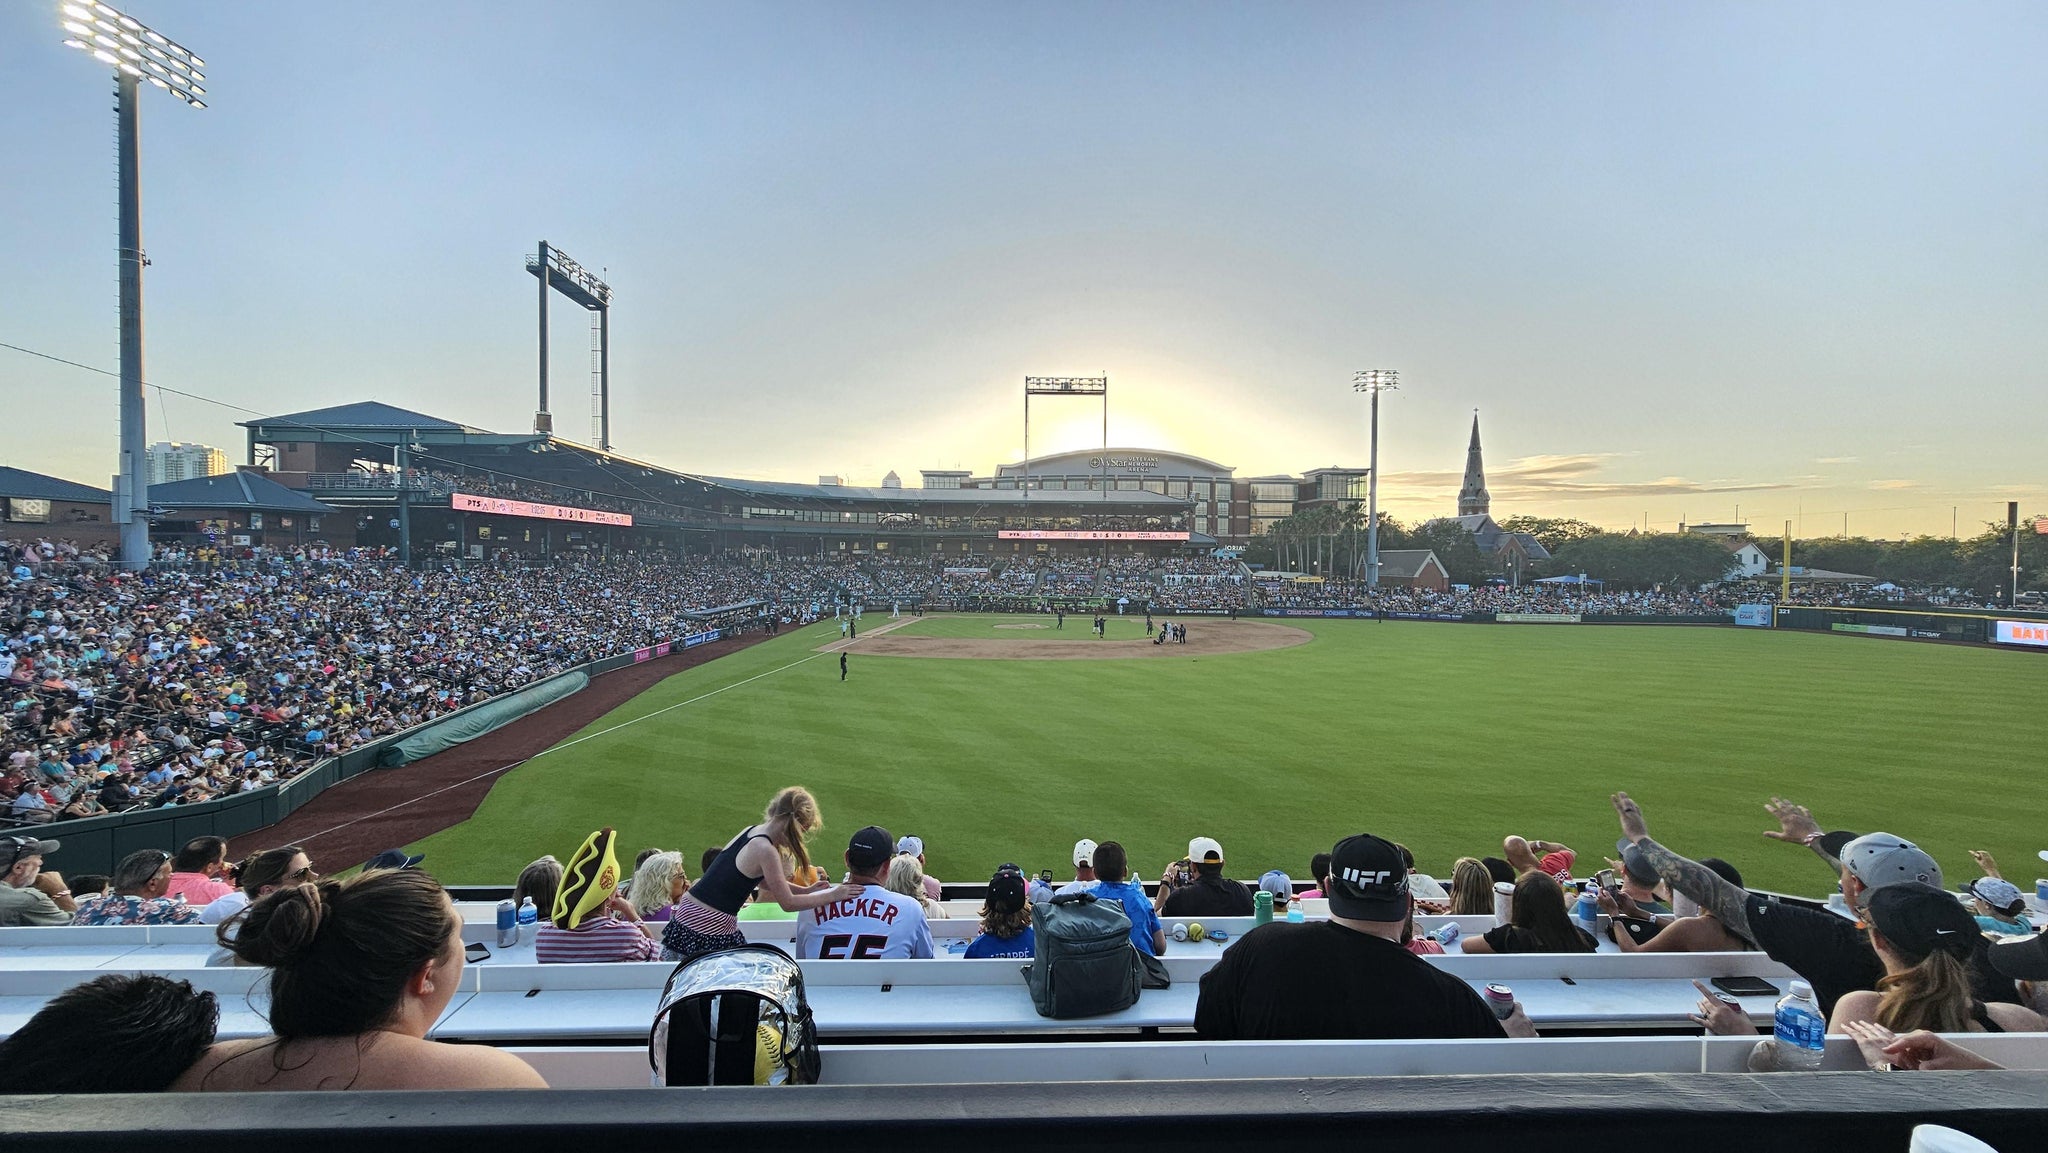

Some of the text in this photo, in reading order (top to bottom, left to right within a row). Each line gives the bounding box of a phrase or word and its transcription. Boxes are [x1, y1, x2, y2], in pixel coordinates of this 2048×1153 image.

[467, 499, 481, 507] PTS
[202, 527, 226, 535] OASIS
[1342, 867, 1391, 890] UFC
[814, 898, 899, 926] HACKER
